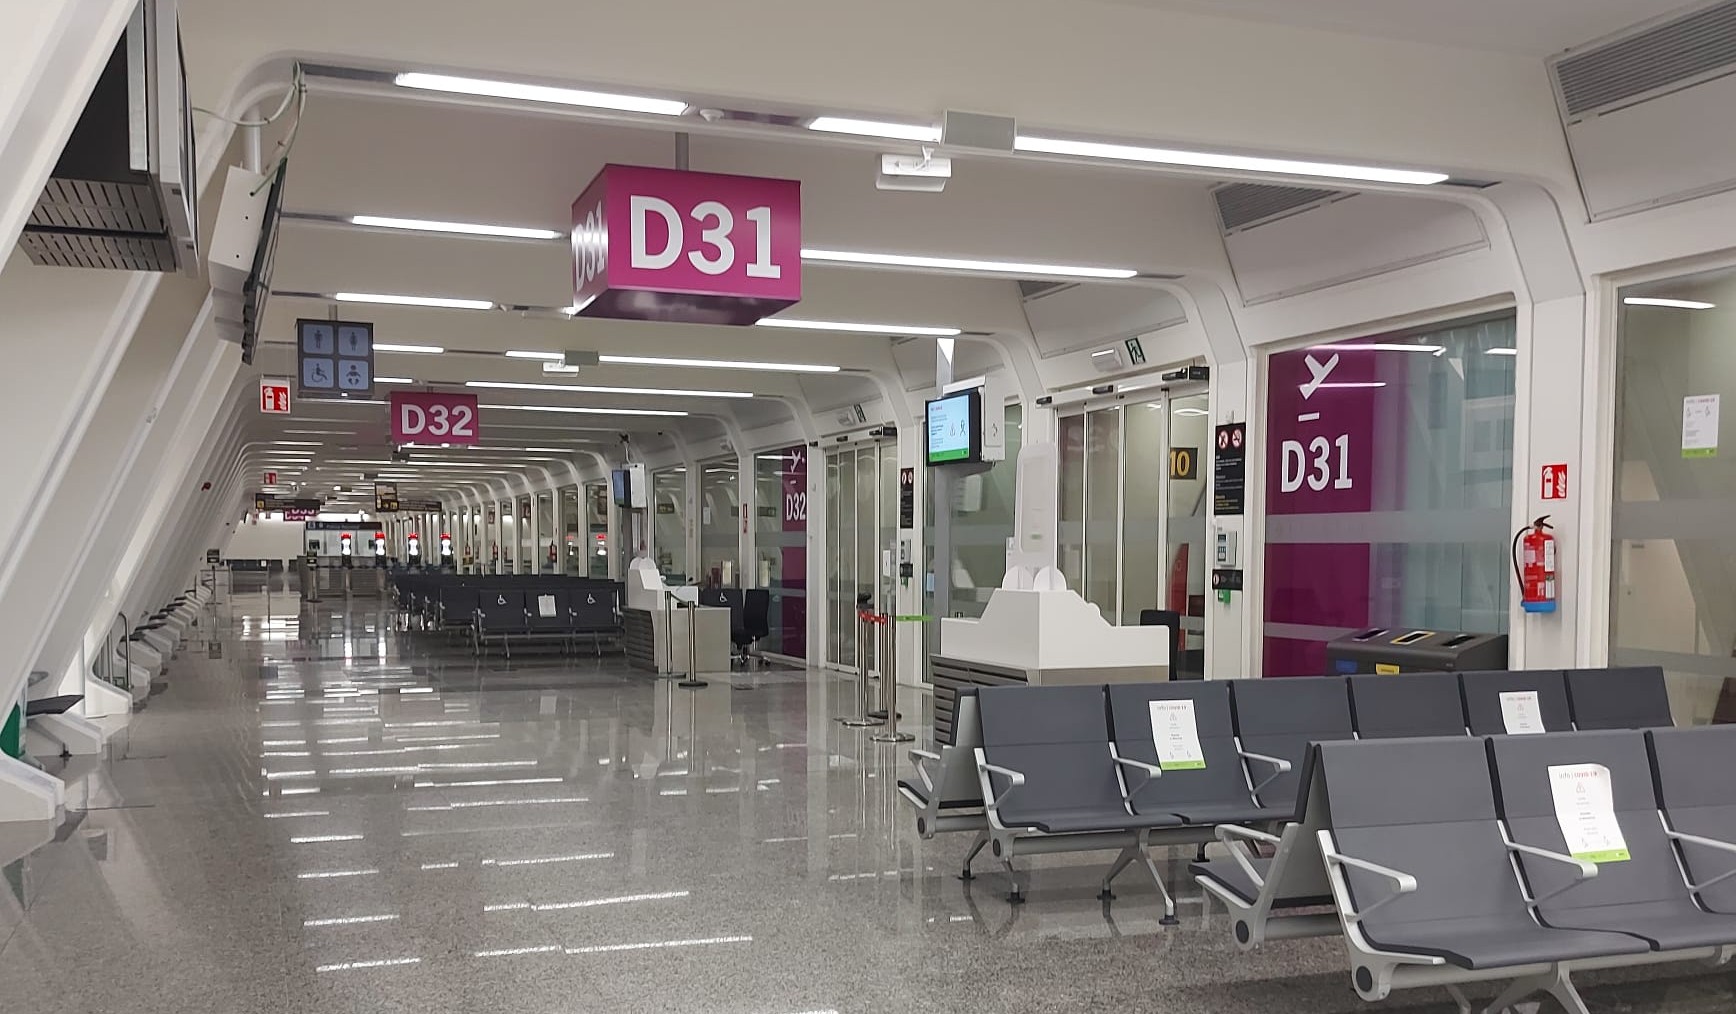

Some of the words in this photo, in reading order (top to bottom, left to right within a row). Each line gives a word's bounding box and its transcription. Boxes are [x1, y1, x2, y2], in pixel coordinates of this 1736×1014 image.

[575, 200, 605, 292] D31
[630, 194, 781, 279] D31
[401, 403, 473, 436] D32
[1281, 434, 1353, 493] D31
[786, 491, 806, 521] D32
